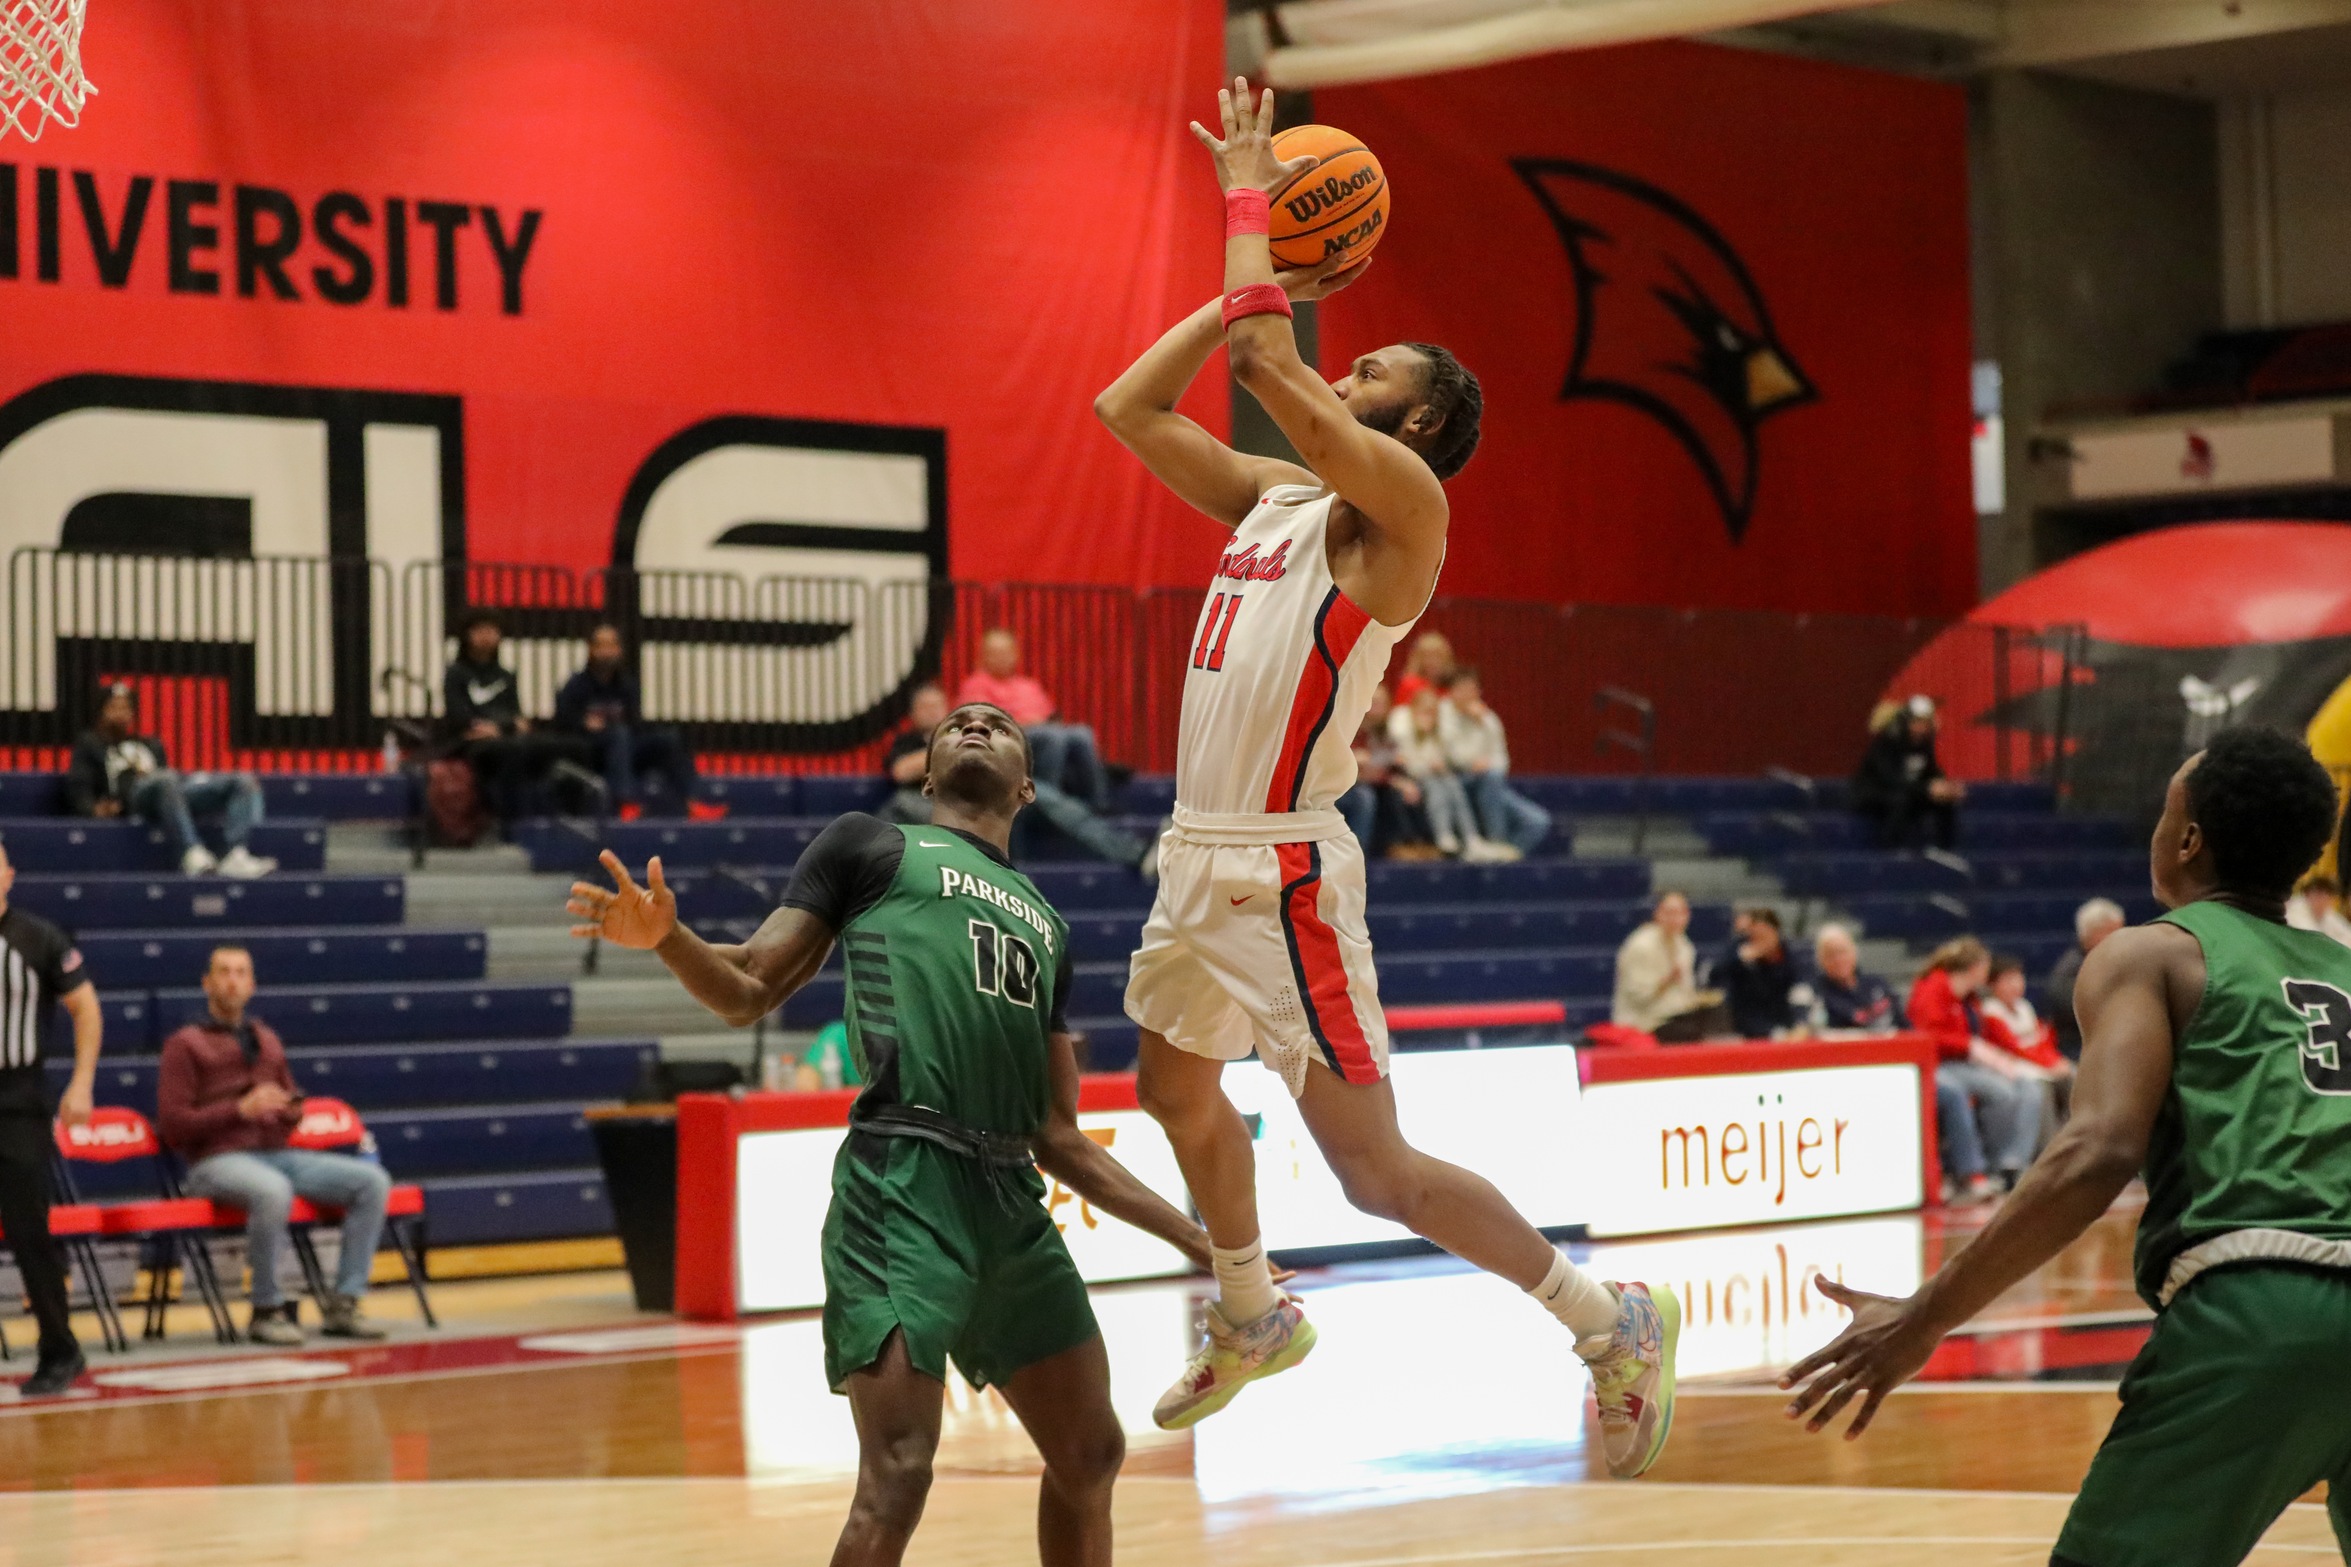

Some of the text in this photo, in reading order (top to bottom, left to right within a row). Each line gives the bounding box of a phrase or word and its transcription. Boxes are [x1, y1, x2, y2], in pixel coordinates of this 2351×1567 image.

[1284, 166, 1377, 223] Wilson
[1324, 208, 1383, 256] NCAA
[1193, 592, 1244, 672] 11
[939, 865, 1053, 955] PARKSIDE
[968, 918, 1039, 1009] 10
[2280, 976, 2351, 1096] 3
[1661, 1093, 1849, 1205] meijer
